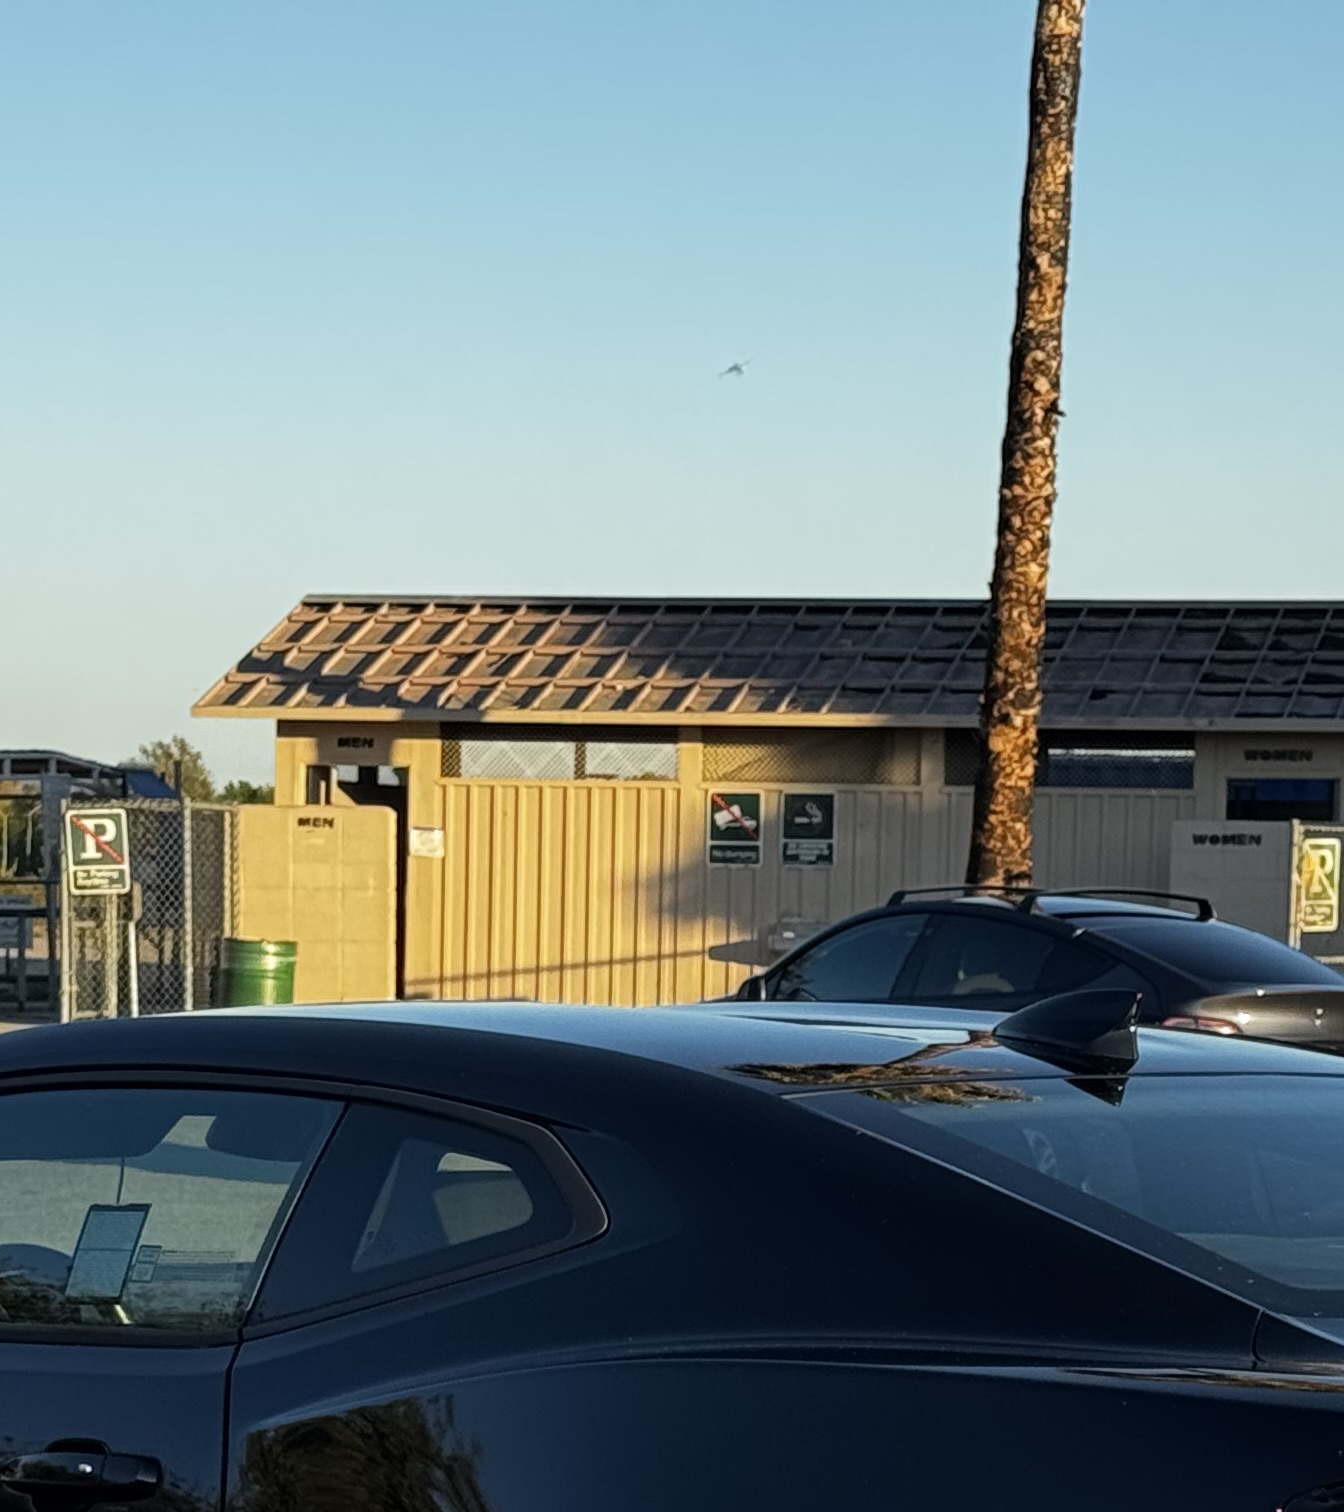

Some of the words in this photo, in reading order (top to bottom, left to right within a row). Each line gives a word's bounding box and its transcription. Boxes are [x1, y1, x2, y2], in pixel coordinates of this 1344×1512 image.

[337, 737, 374, 748] MEN
[1243, 749, 1313, 762] WOMEN
[297, 817, 334, 829] MEN
[80, 818, 117, 860] P
[1193, 834, 1262, 846] WOMEN
